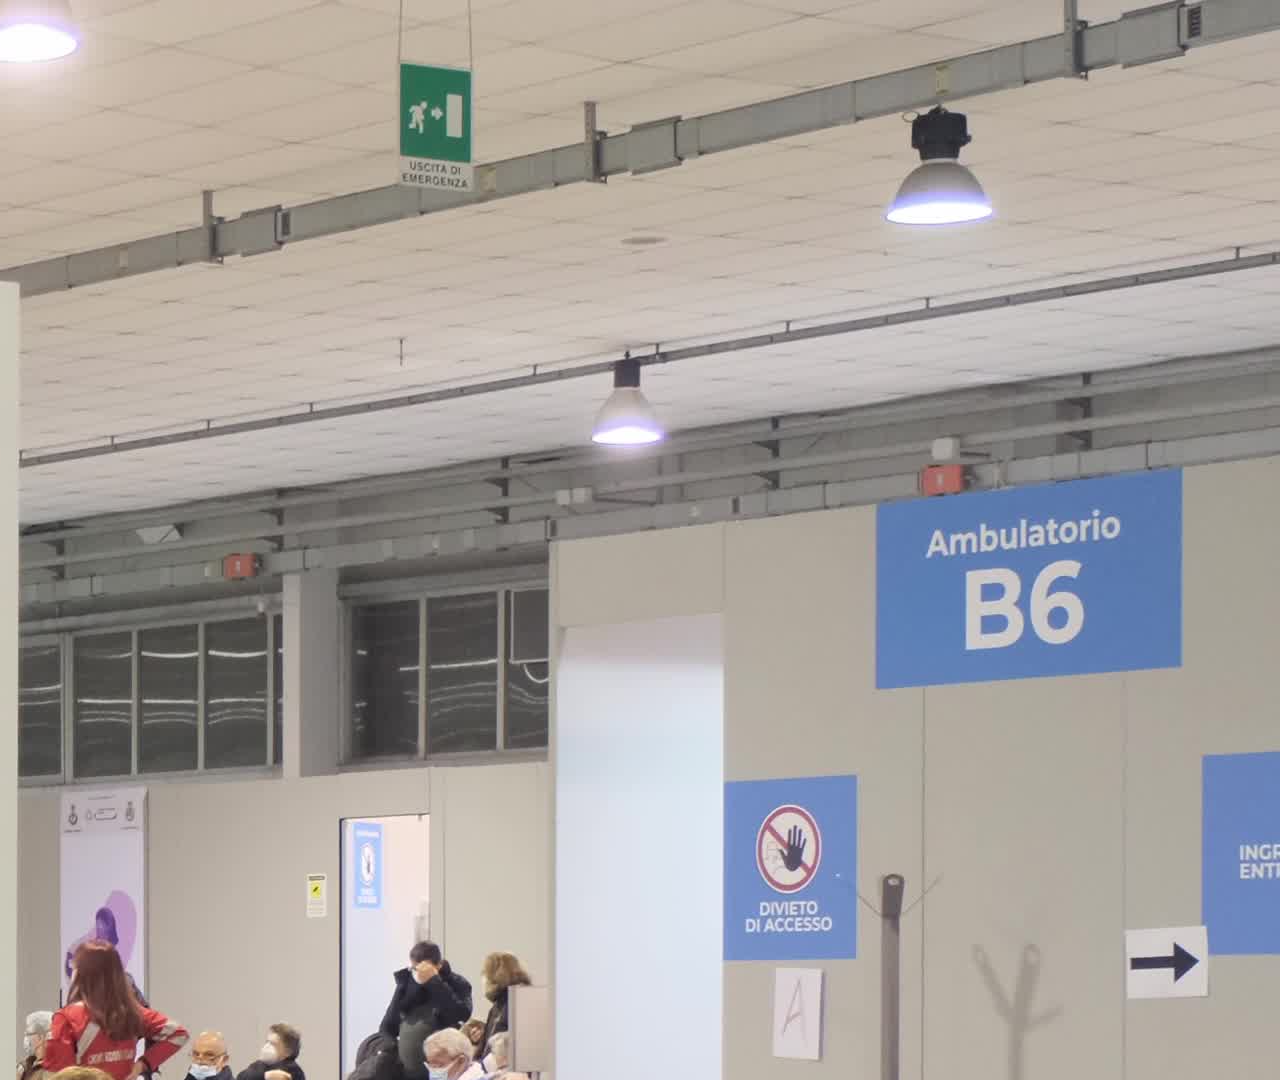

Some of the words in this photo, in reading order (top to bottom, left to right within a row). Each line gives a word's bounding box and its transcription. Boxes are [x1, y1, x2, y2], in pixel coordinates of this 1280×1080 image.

[409, 160, 448, 175] USCITA
[450, 166, 461, 176] DI
[402, 172, 468, 188] EMERGENZA
[926, 510, 1121, 559] Ambulatorio
[965, 559, 1085, 650] B6
[759, 901, 818, 916] DIVIETO
[745, 918, 760, 933] DI
[764, 917, 833, 932] ACCESSO
[781, 977, 808, 1047] A
